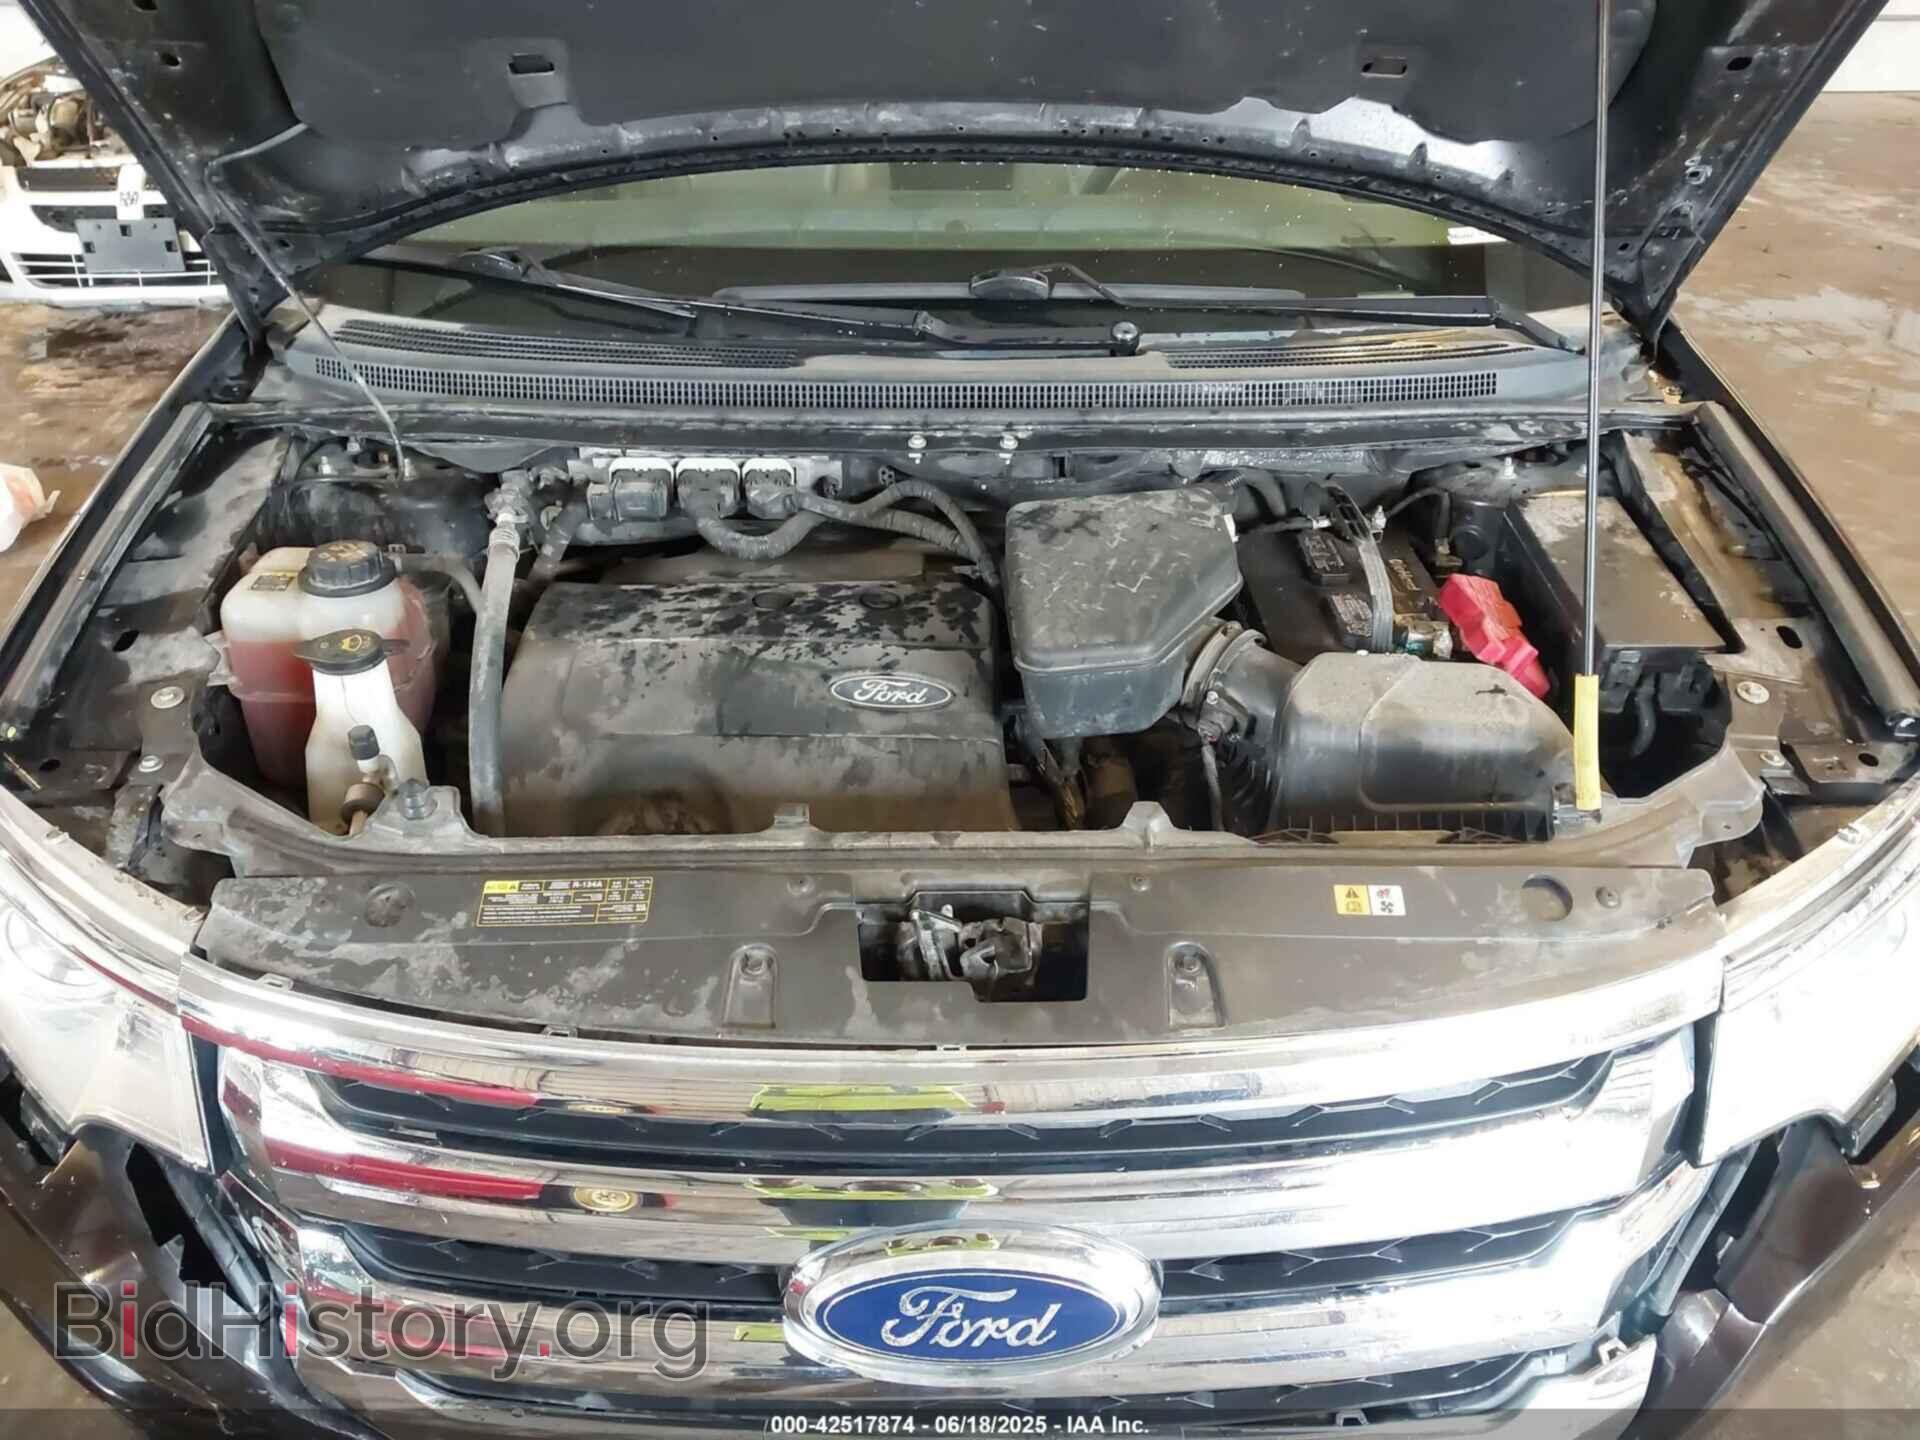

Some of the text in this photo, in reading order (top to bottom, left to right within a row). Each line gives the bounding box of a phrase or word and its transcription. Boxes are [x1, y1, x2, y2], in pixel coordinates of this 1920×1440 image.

[853, 679, 928, 703] Ford
[572, 880, 602, 888] R-134A
[880, 1286, 1062, 1348] Ford
